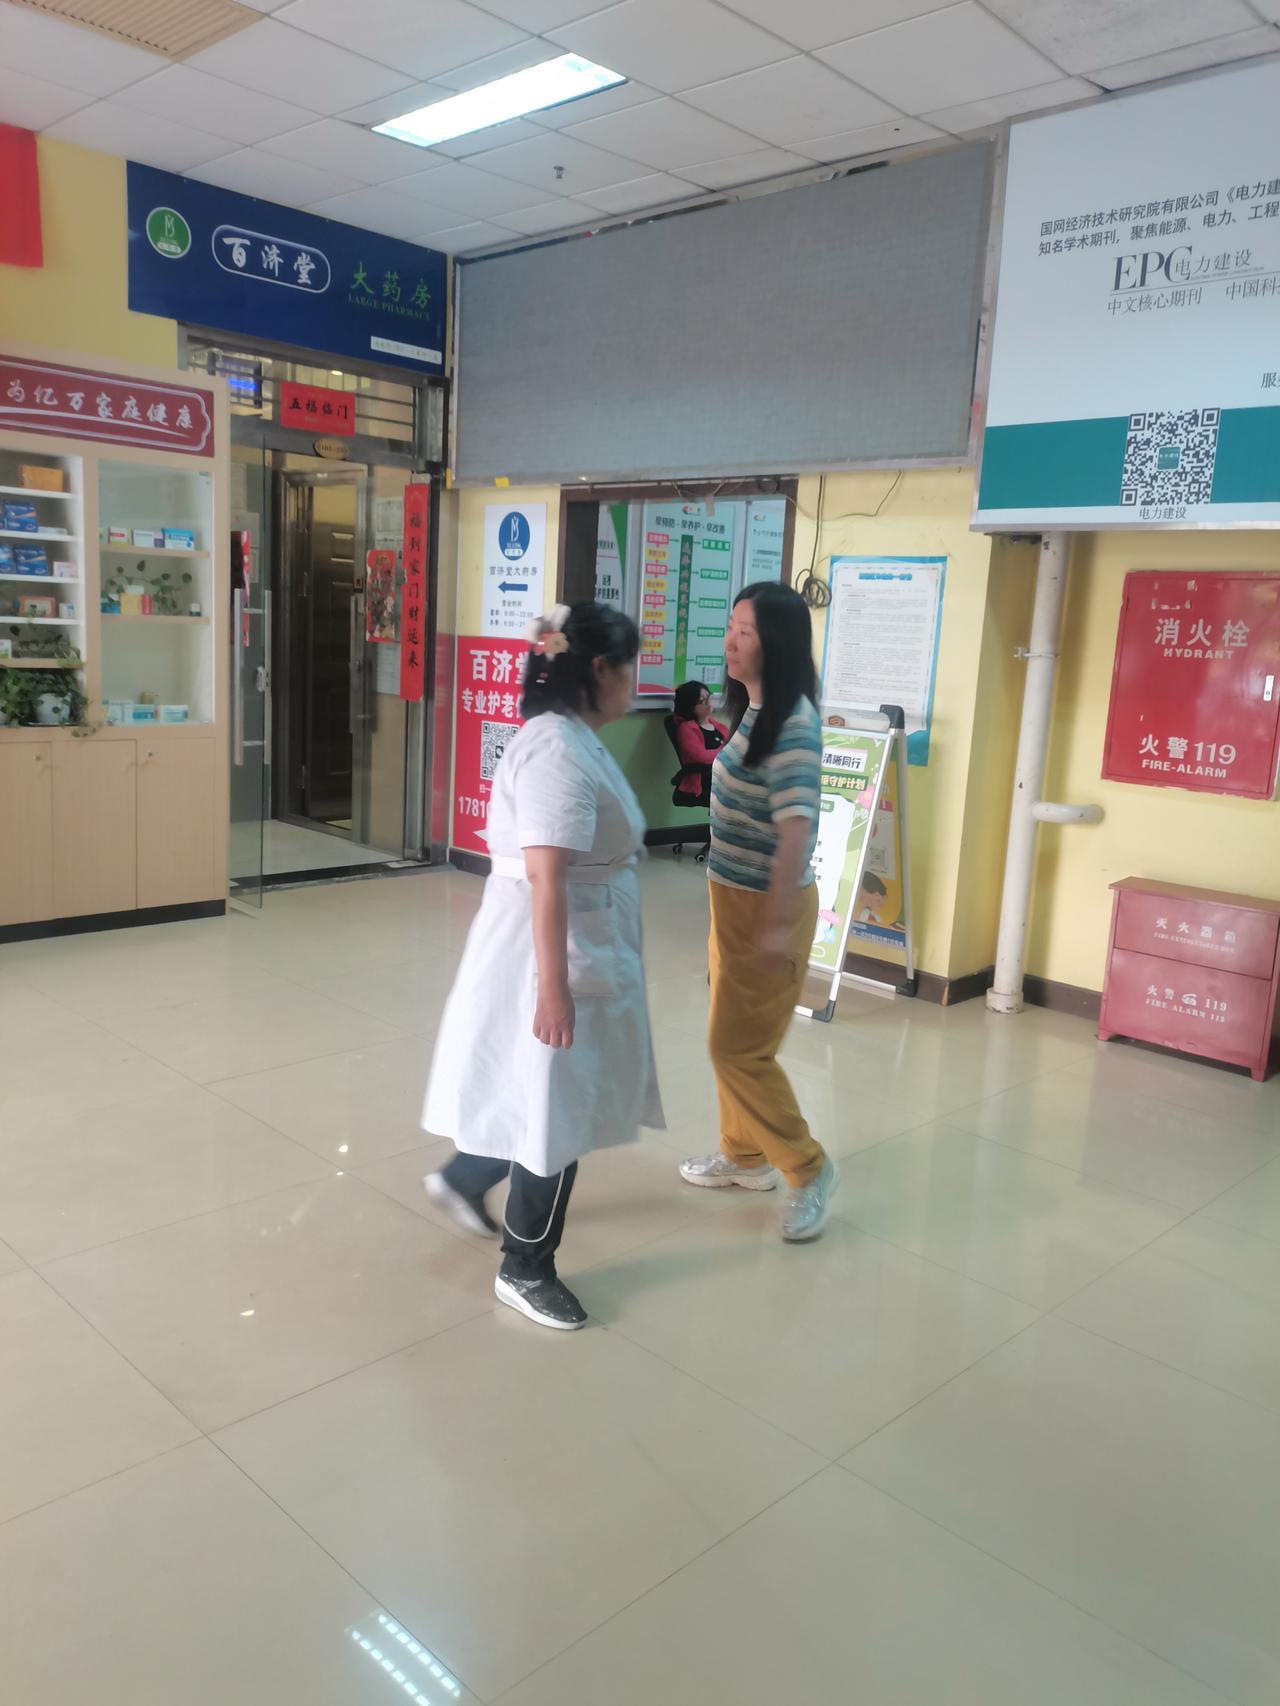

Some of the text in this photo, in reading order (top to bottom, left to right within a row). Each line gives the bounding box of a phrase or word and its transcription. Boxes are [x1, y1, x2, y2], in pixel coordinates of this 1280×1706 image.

[222, 237, 316, 285] 百济堂
[1112, 245, 1193, 291] EPC
[1174, 248, 1252, 277] 电力建设
[350, 261, 432, 310] 大药房
[1107, 275, 1280, 316] 中文核心期刊 中国科
[288, 397, 348, 421] 五福临门
[1139, 506, 1187, 520] 电力建设
[1154, 617, 1250, 648] 消火栓
[1163, 647, 1235, 660] HYDRANT
[462, 687, 524, 719] 专业护老
[822, 752, 862, 770] 清晰同行
[1141, 758, 1228, 779] FIRE-ALARM
[1155, 917, 1236, 943] 灭火器箱
[1146, 984, 1228, 1012] 火警 119
